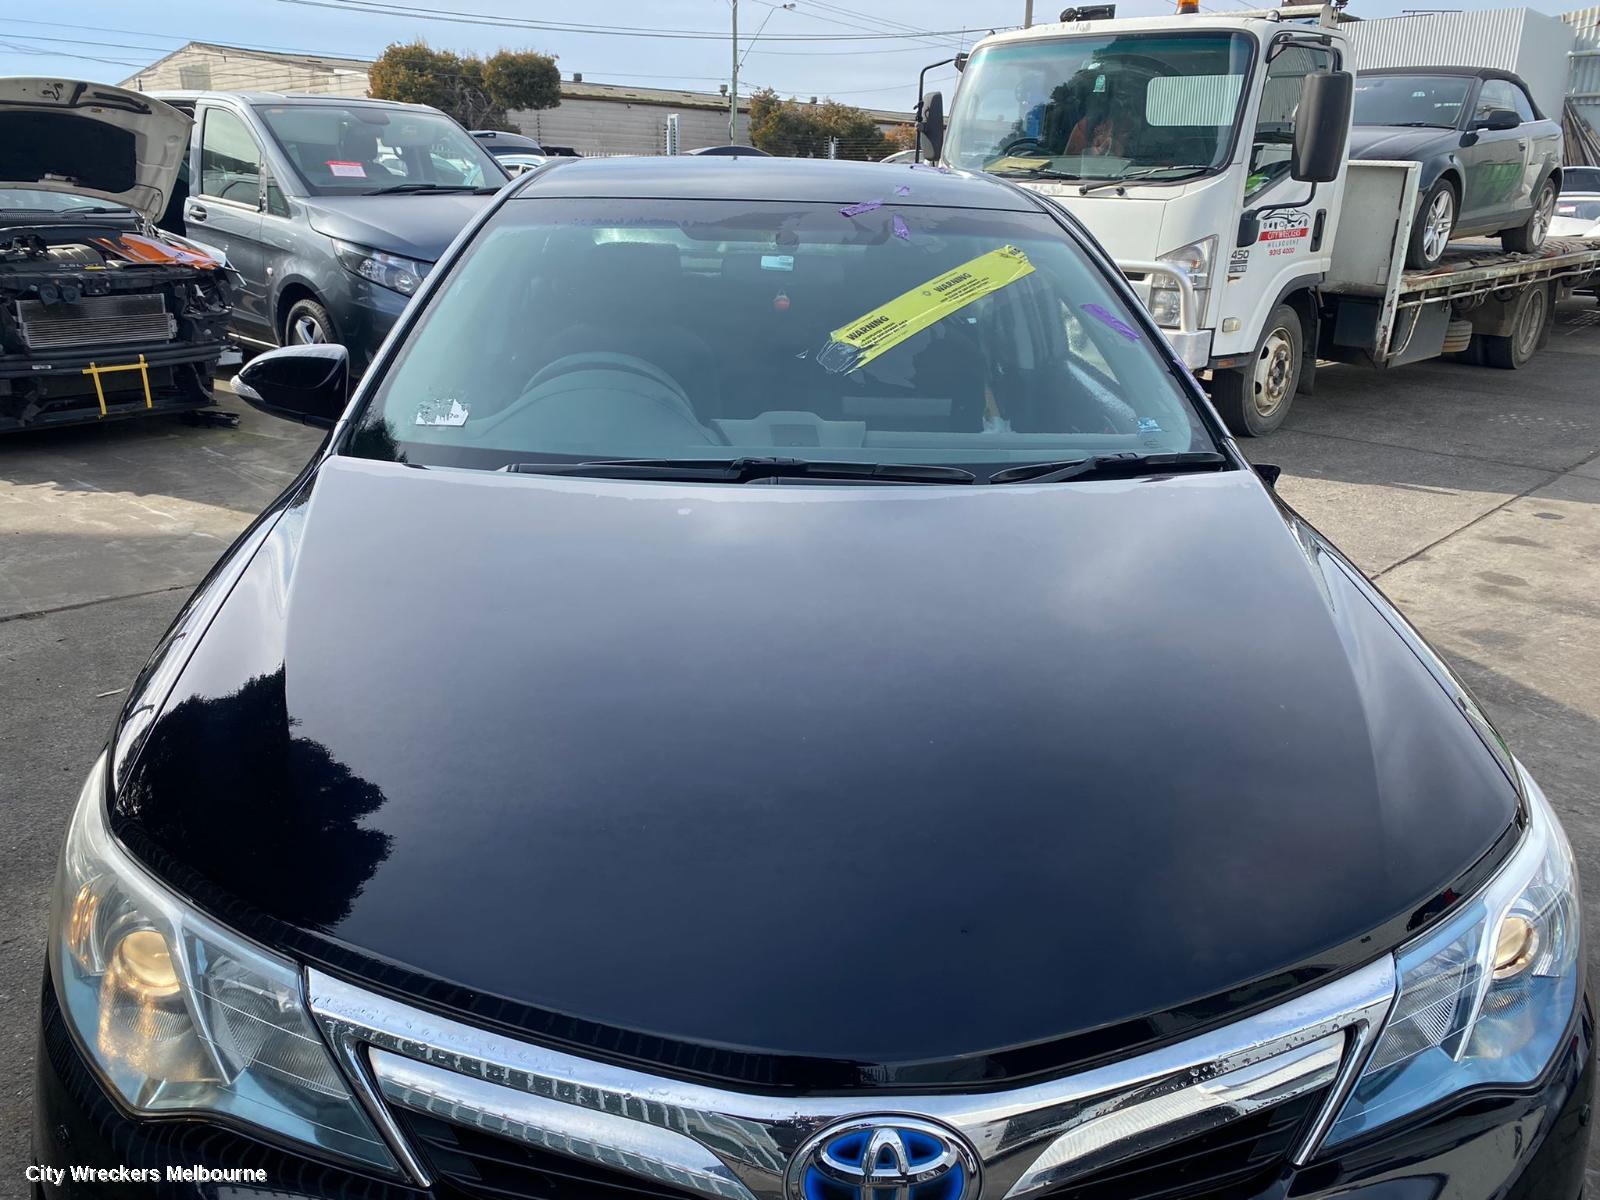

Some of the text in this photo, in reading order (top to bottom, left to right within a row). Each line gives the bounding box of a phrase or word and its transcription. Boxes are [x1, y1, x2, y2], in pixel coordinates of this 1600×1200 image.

[1231, 250, 1249, 260] 450
[933, 272, 972, 293] WARNING
[846, 315, 890, 341] WARNING
